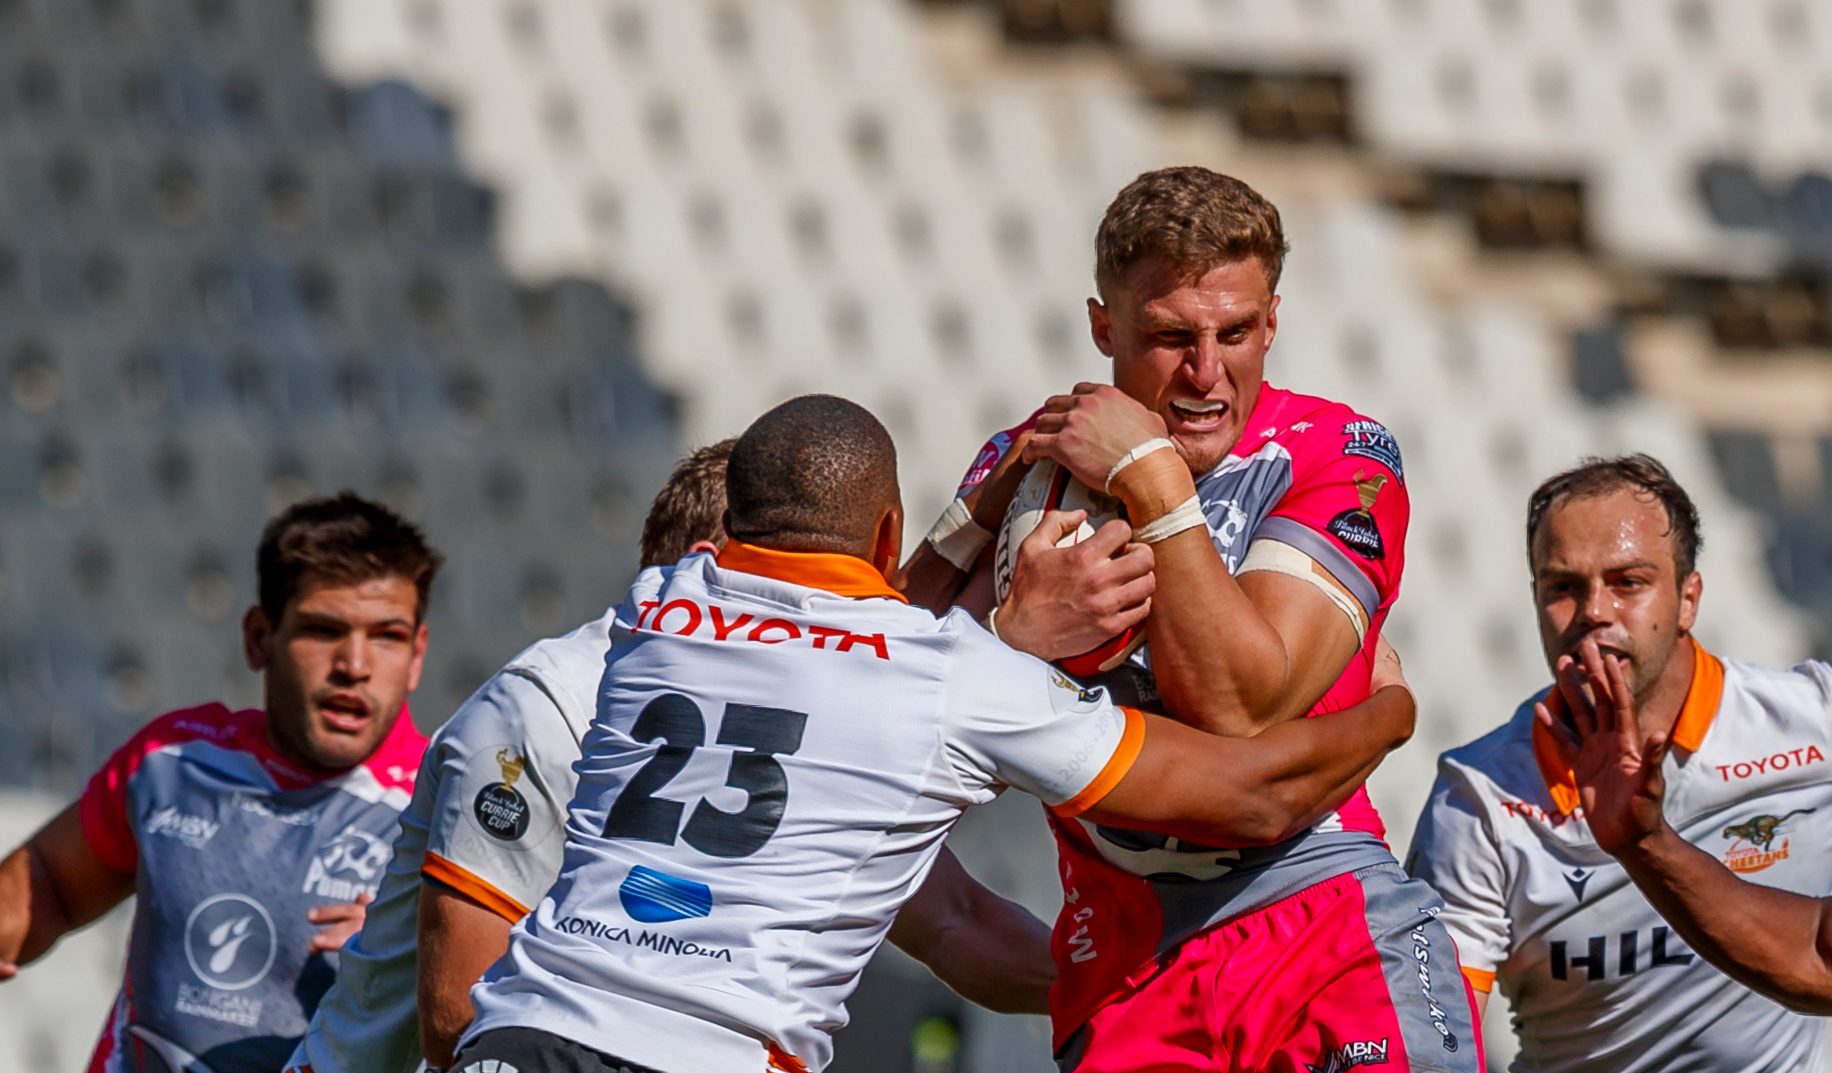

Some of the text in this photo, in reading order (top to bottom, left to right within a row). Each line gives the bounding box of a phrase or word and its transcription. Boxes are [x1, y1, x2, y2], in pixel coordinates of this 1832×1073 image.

[601, 692, 808, 859] 23
[1715, 744, 1825, 782] TOYOTA
[480, 800, 521, 824] CURRIE
[487, 815, 512, 831] CUP
[554, 915, 632, 946] KONICA
[1335, 1038, 1388, 1069] MBN
